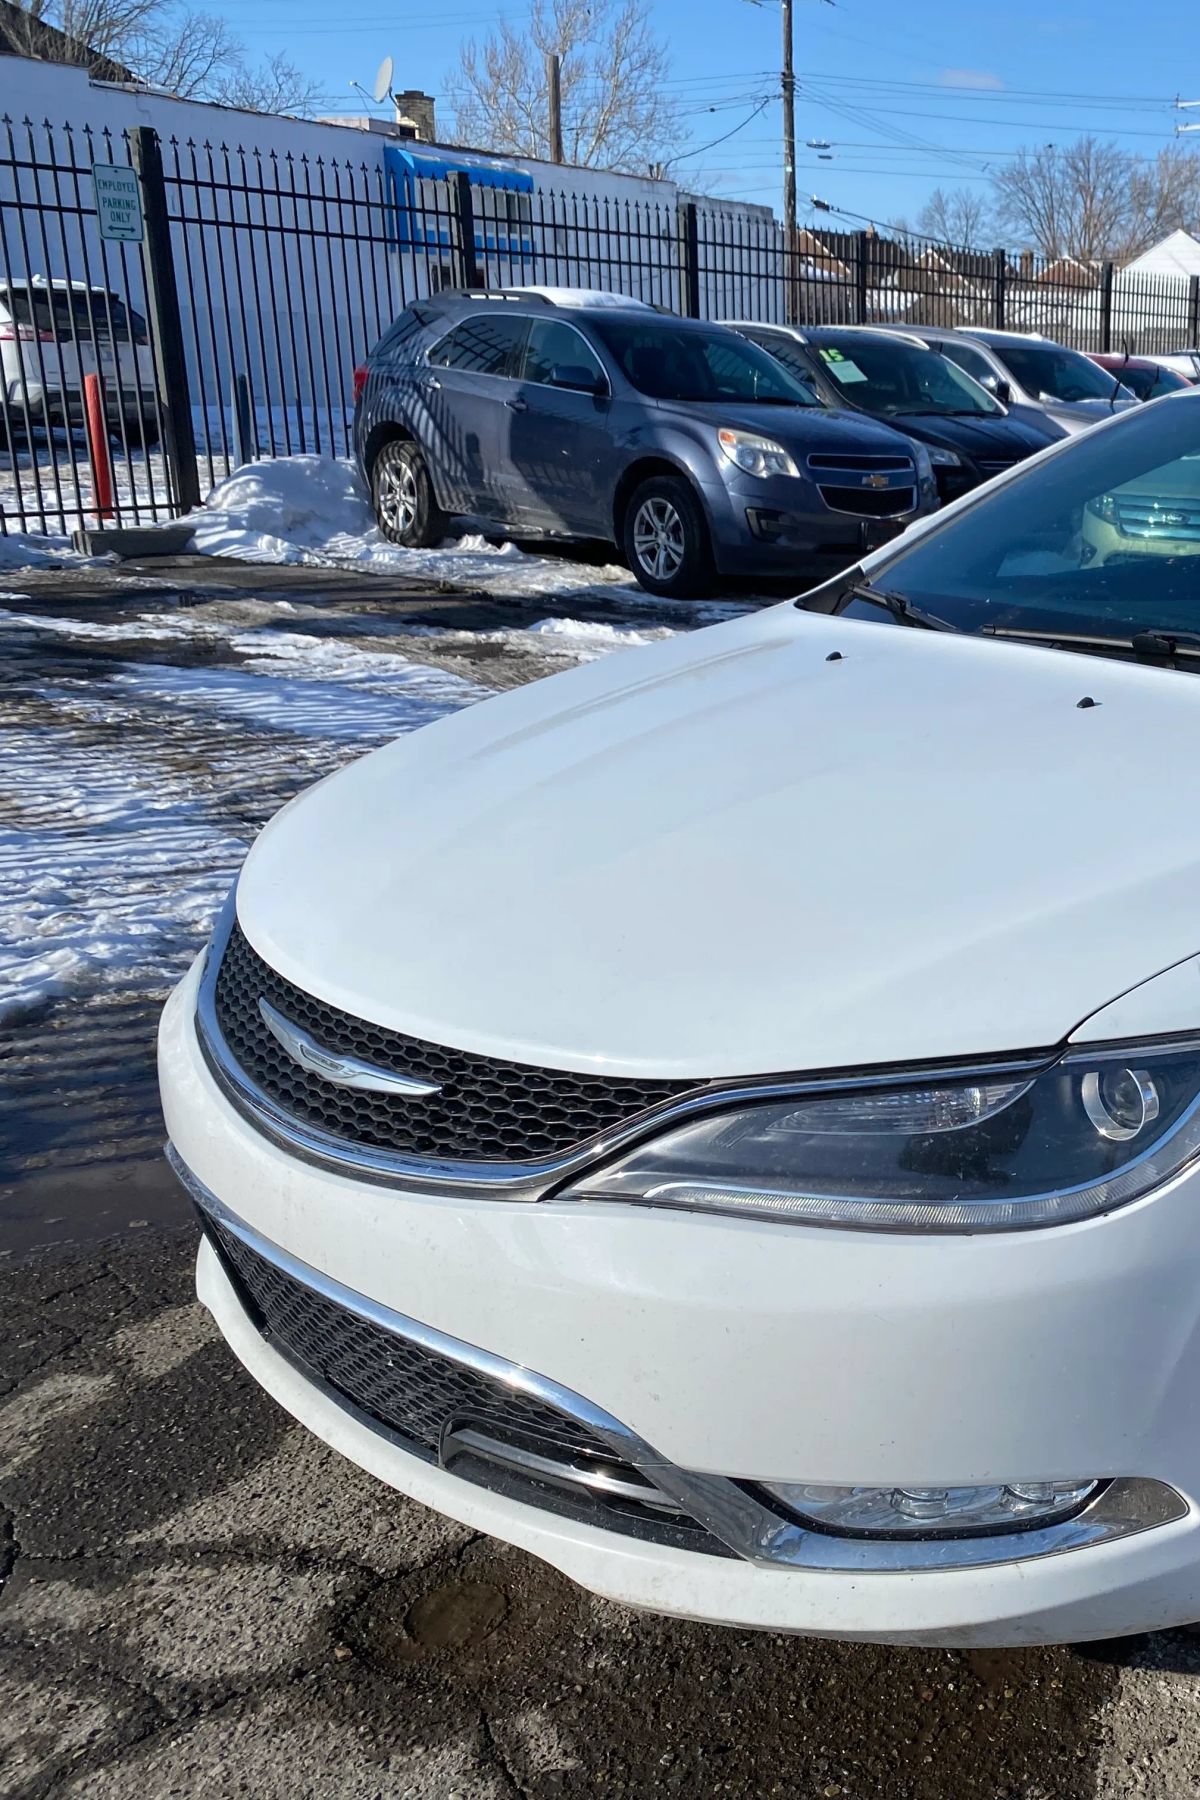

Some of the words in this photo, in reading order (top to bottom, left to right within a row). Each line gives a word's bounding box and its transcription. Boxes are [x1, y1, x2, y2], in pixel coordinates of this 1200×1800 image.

[98, 179, 136, 193] EMPLOYEE
[102, 196, 136, 211] PARKING
[110, 211, 131, 223] ONLY
[818, 349, 844, 362] 15
